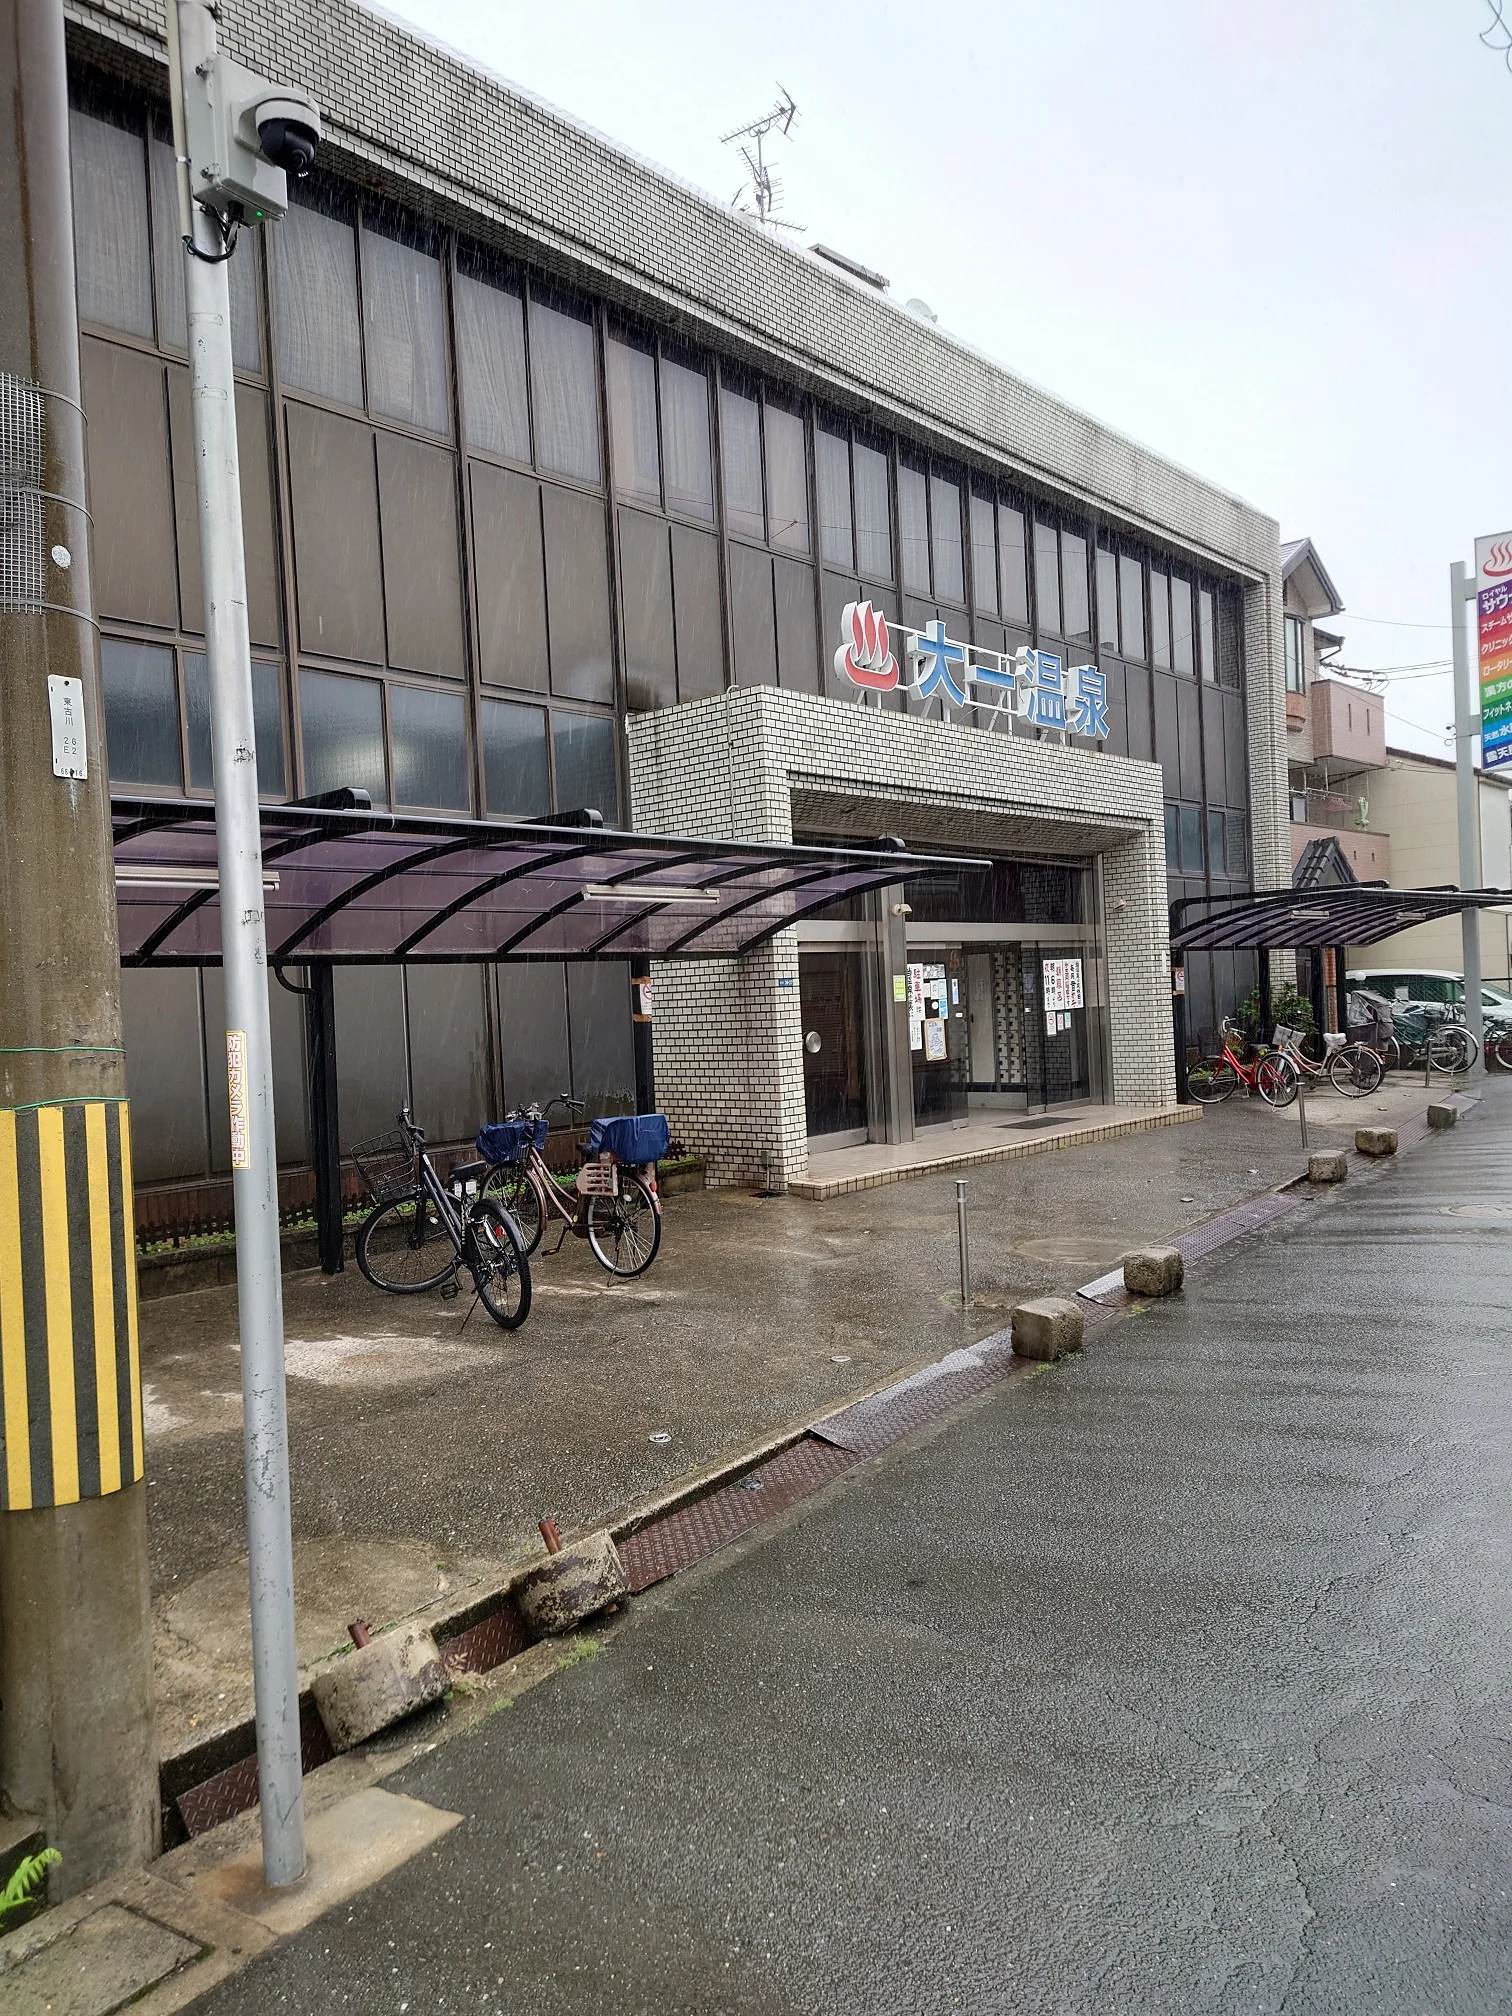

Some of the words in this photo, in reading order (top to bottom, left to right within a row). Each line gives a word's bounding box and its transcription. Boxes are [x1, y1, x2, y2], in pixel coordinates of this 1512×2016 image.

[1482, 585, 1508, 600] ロイヤル
[1483, 593, 1512, 614] サウ
[907, 619, 1111, 740] 大一温泉
[227, 1035, 245, 1165] 防犯カメラ作動中
